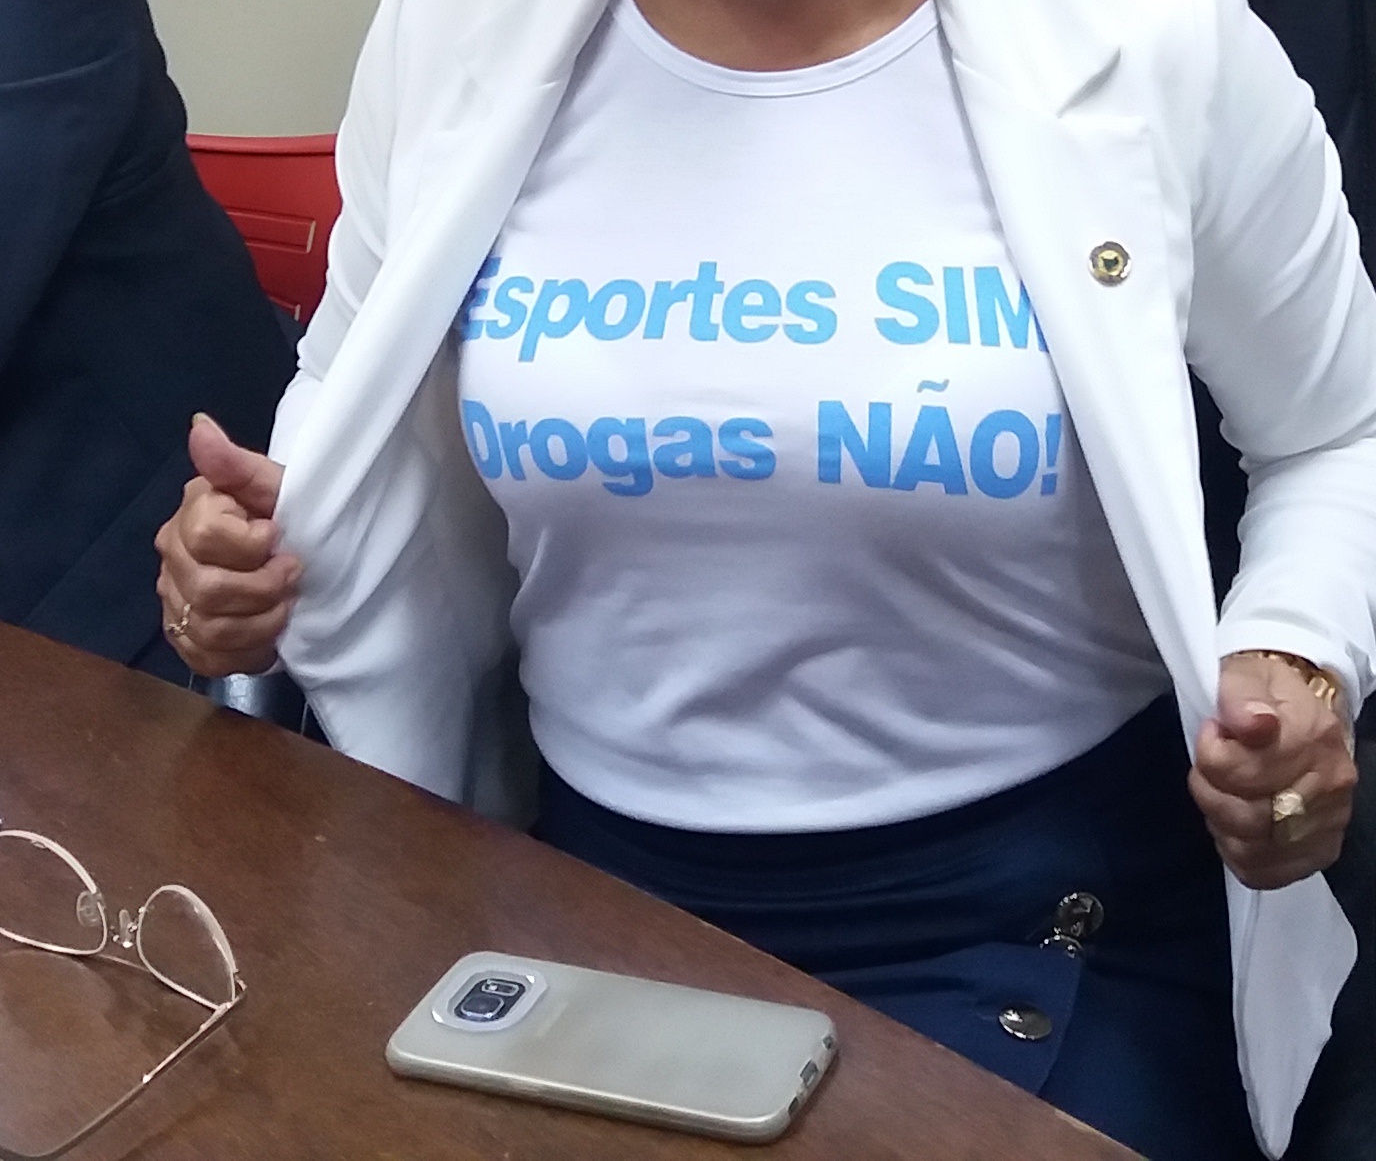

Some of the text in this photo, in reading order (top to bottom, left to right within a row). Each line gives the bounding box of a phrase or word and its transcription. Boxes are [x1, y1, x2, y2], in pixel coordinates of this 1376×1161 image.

[461, 257, 1049, 362] Esportes SIM
[462, 379, 1062, 499] Drogas NÃO!
